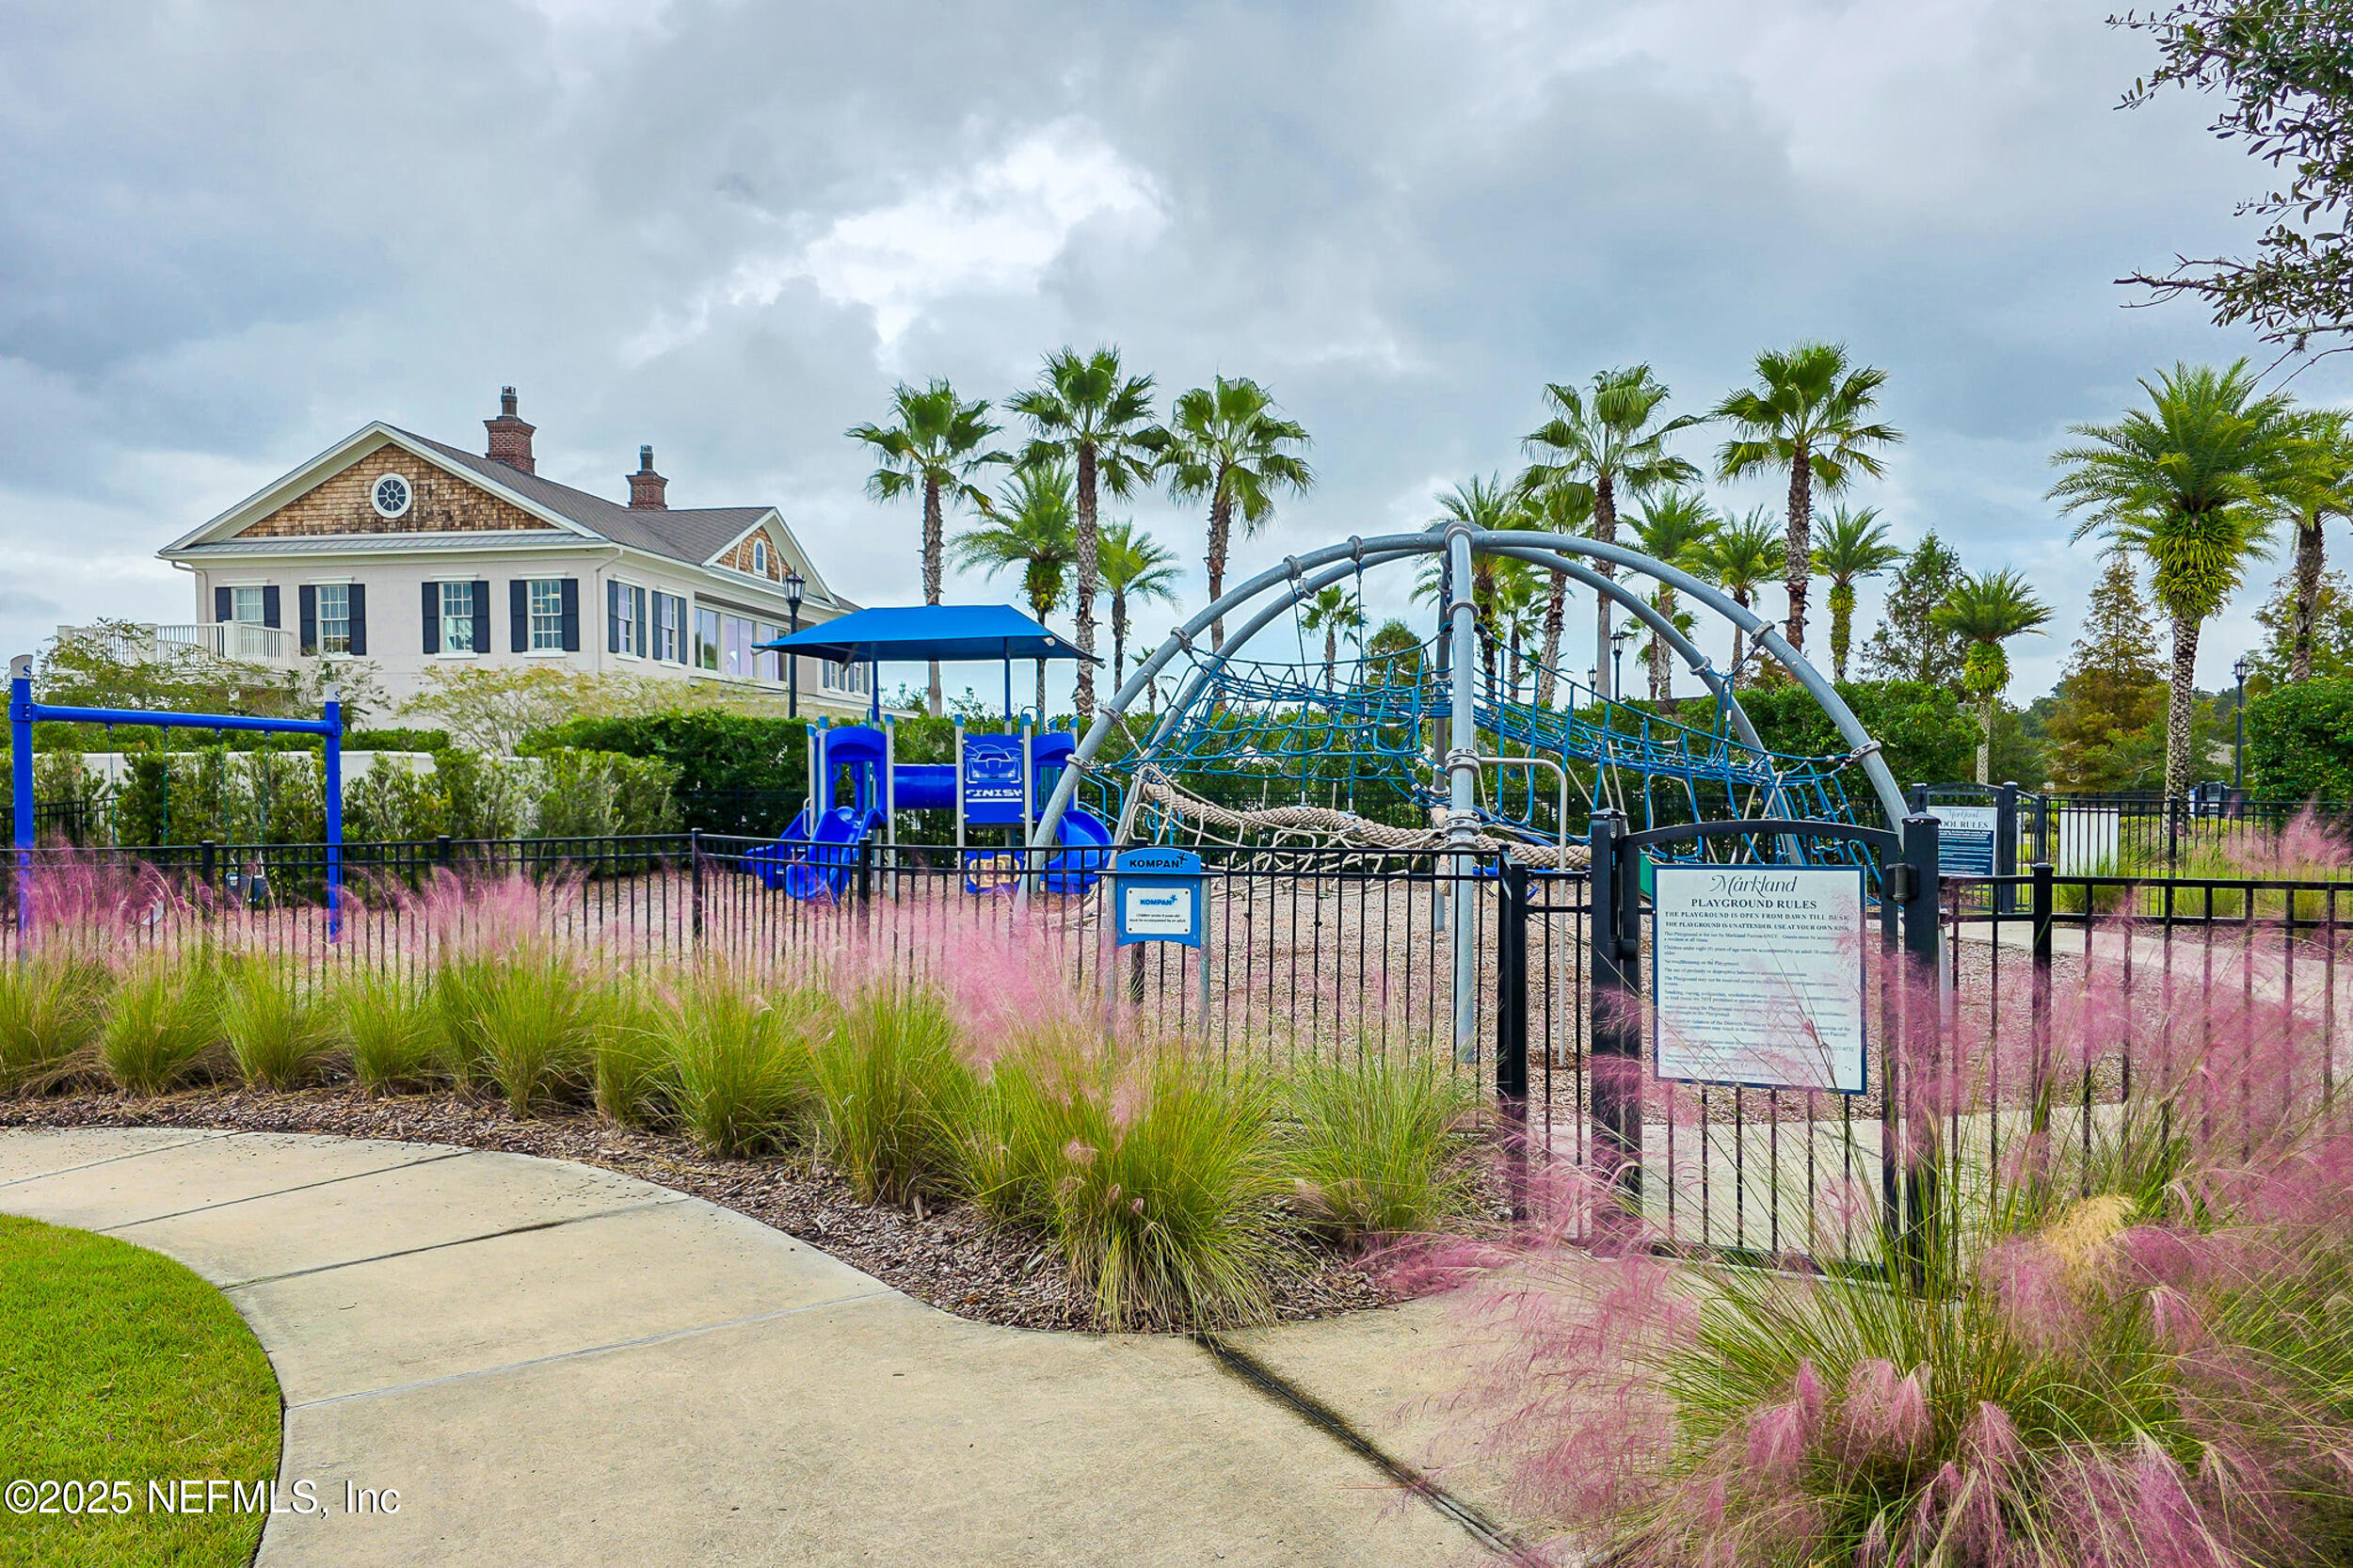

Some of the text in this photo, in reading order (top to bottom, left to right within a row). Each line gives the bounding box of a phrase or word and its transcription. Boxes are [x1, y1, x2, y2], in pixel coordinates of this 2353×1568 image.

[1940, 820, 1959, 828] OOL
[1709, 874, 1798, 898] Markland
[1691, 898, 1817, 909] PLAYGROUND RULES
